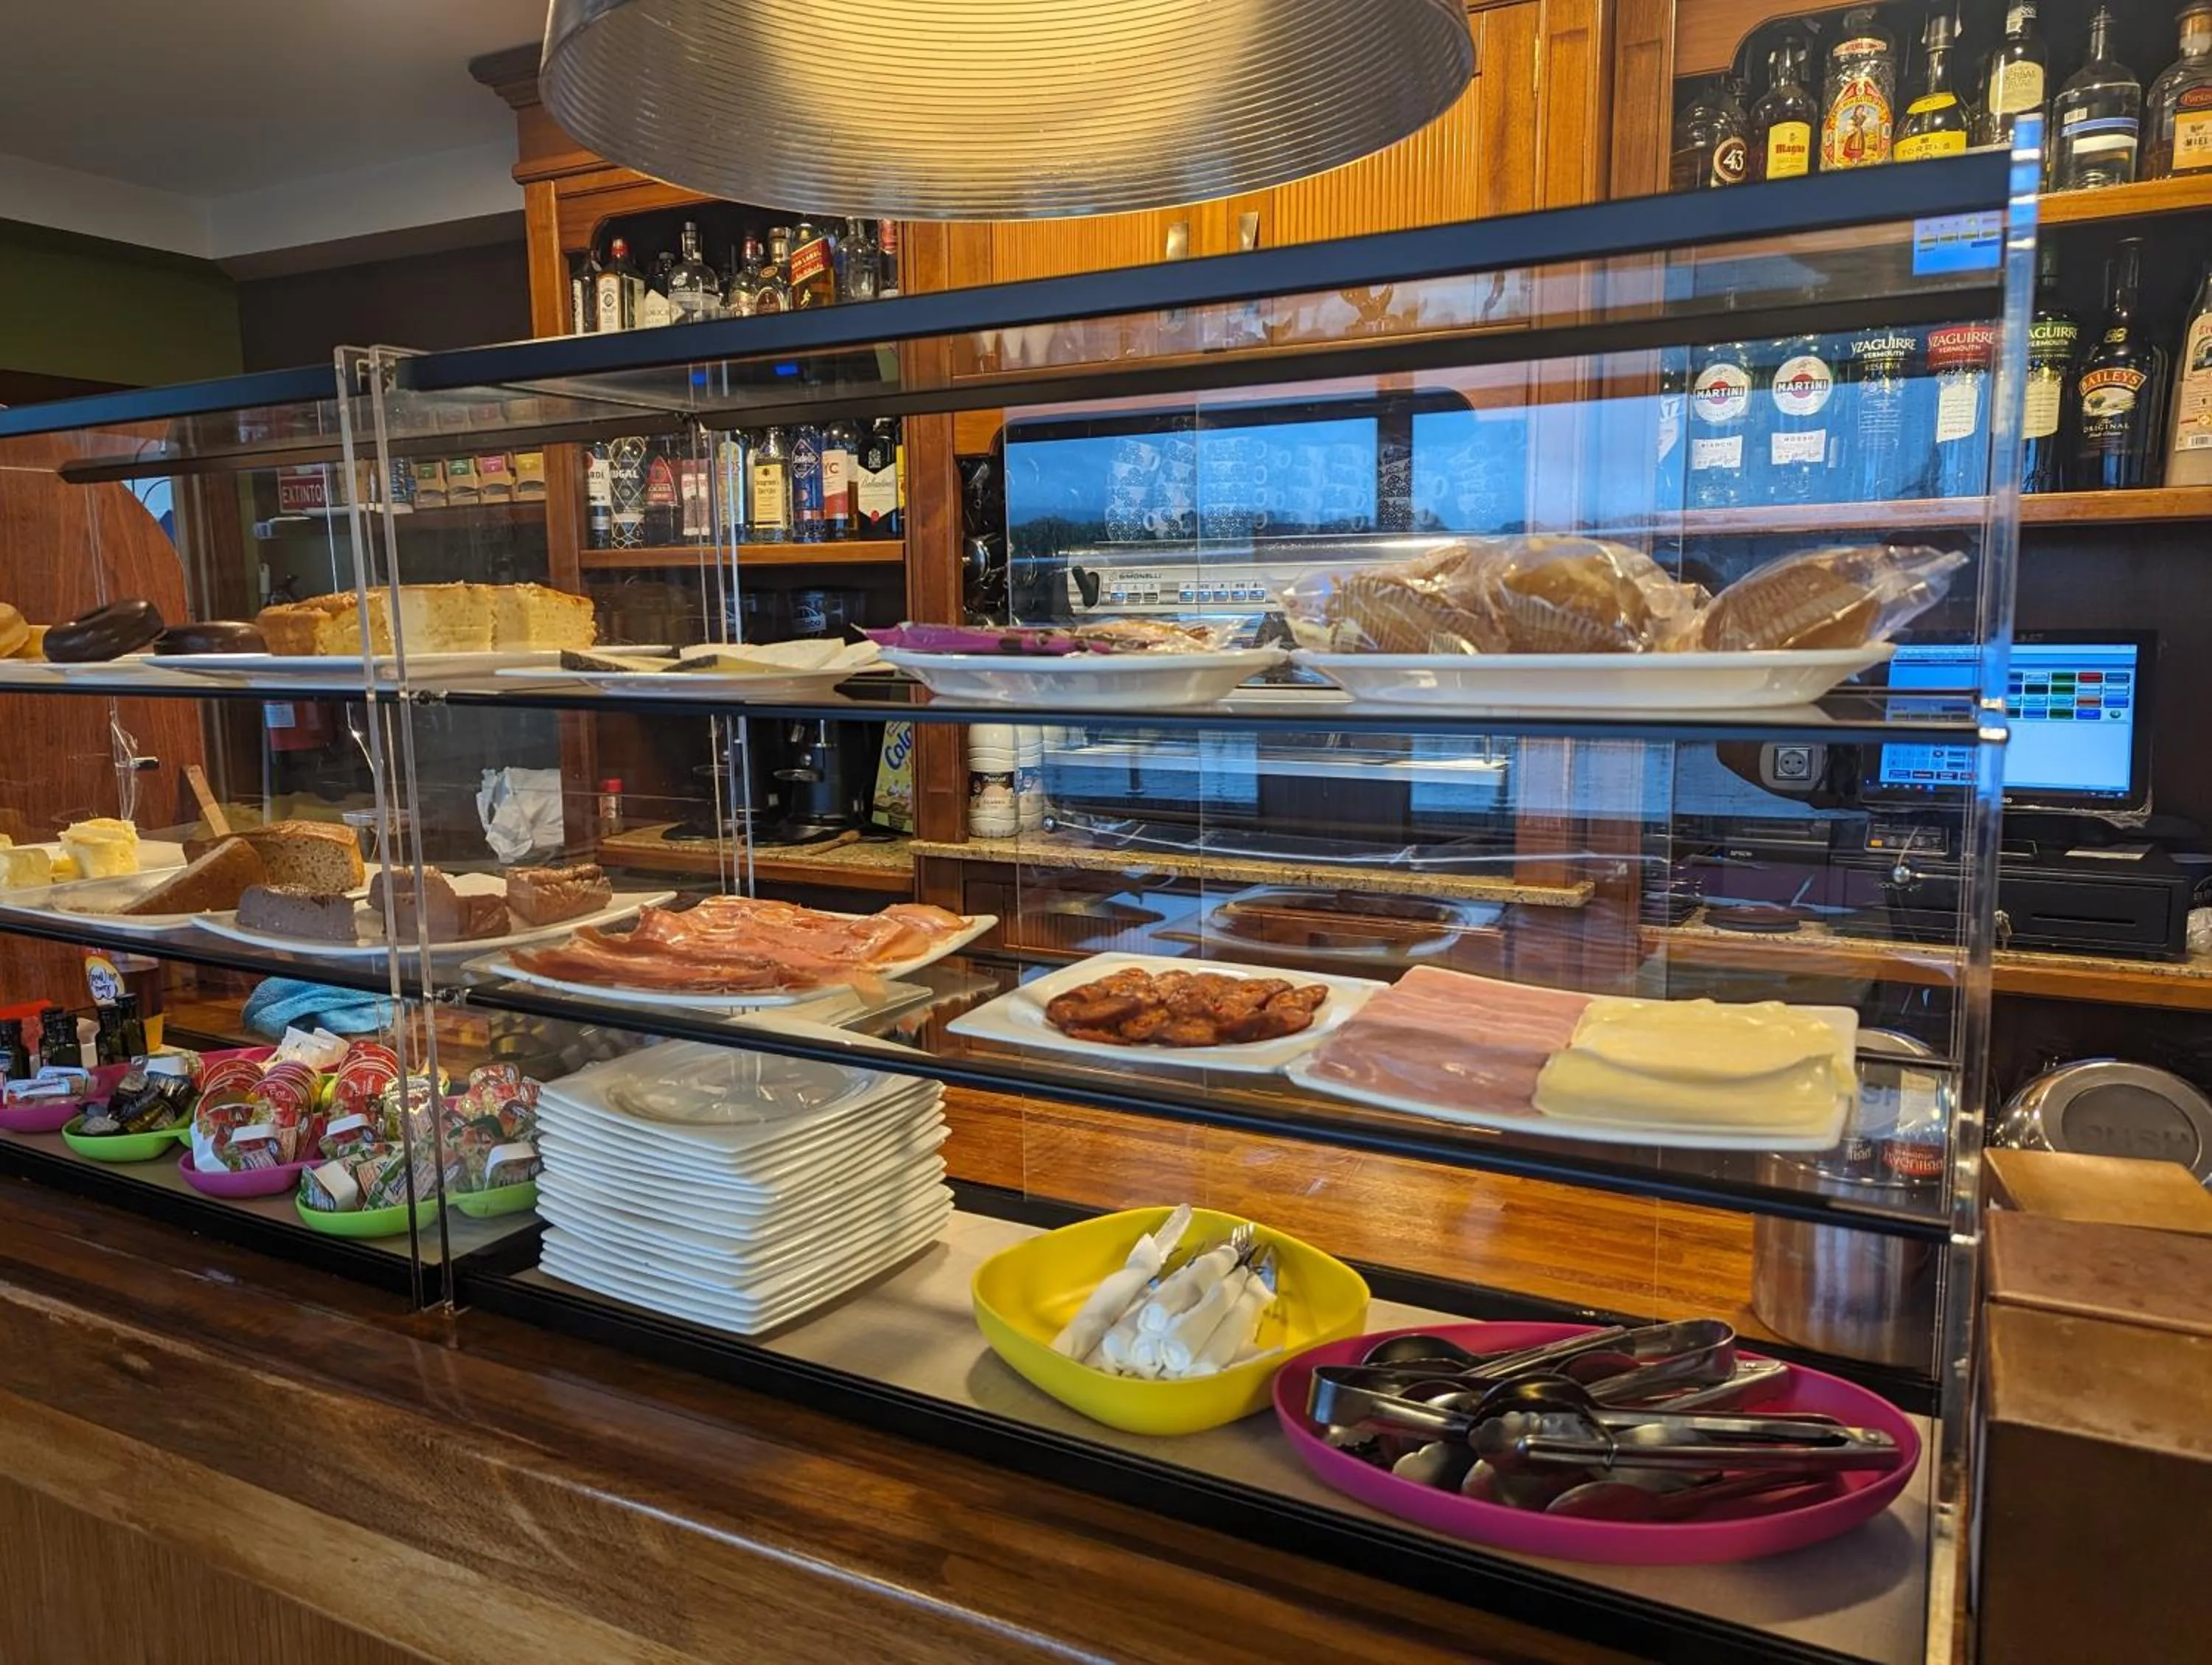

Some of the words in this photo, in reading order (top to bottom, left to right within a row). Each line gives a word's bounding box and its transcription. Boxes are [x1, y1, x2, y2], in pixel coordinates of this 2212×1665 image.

[1723, 150, 1744, 170] 43
[1850, 337, 1916, 358] YZAGUIRRE
[1927, 331, 1994, 352] YZAGUIRRE
[1938, 344, 1982, 353] VERMOUTH
[1863, 350, 1905, 359] VERMOUTH
[1781, 378, 1827, 393] MARTINI
[2081, 369, 2140, 394] BAILEYS
[1697, 389, 1744, 401] MARTINI
